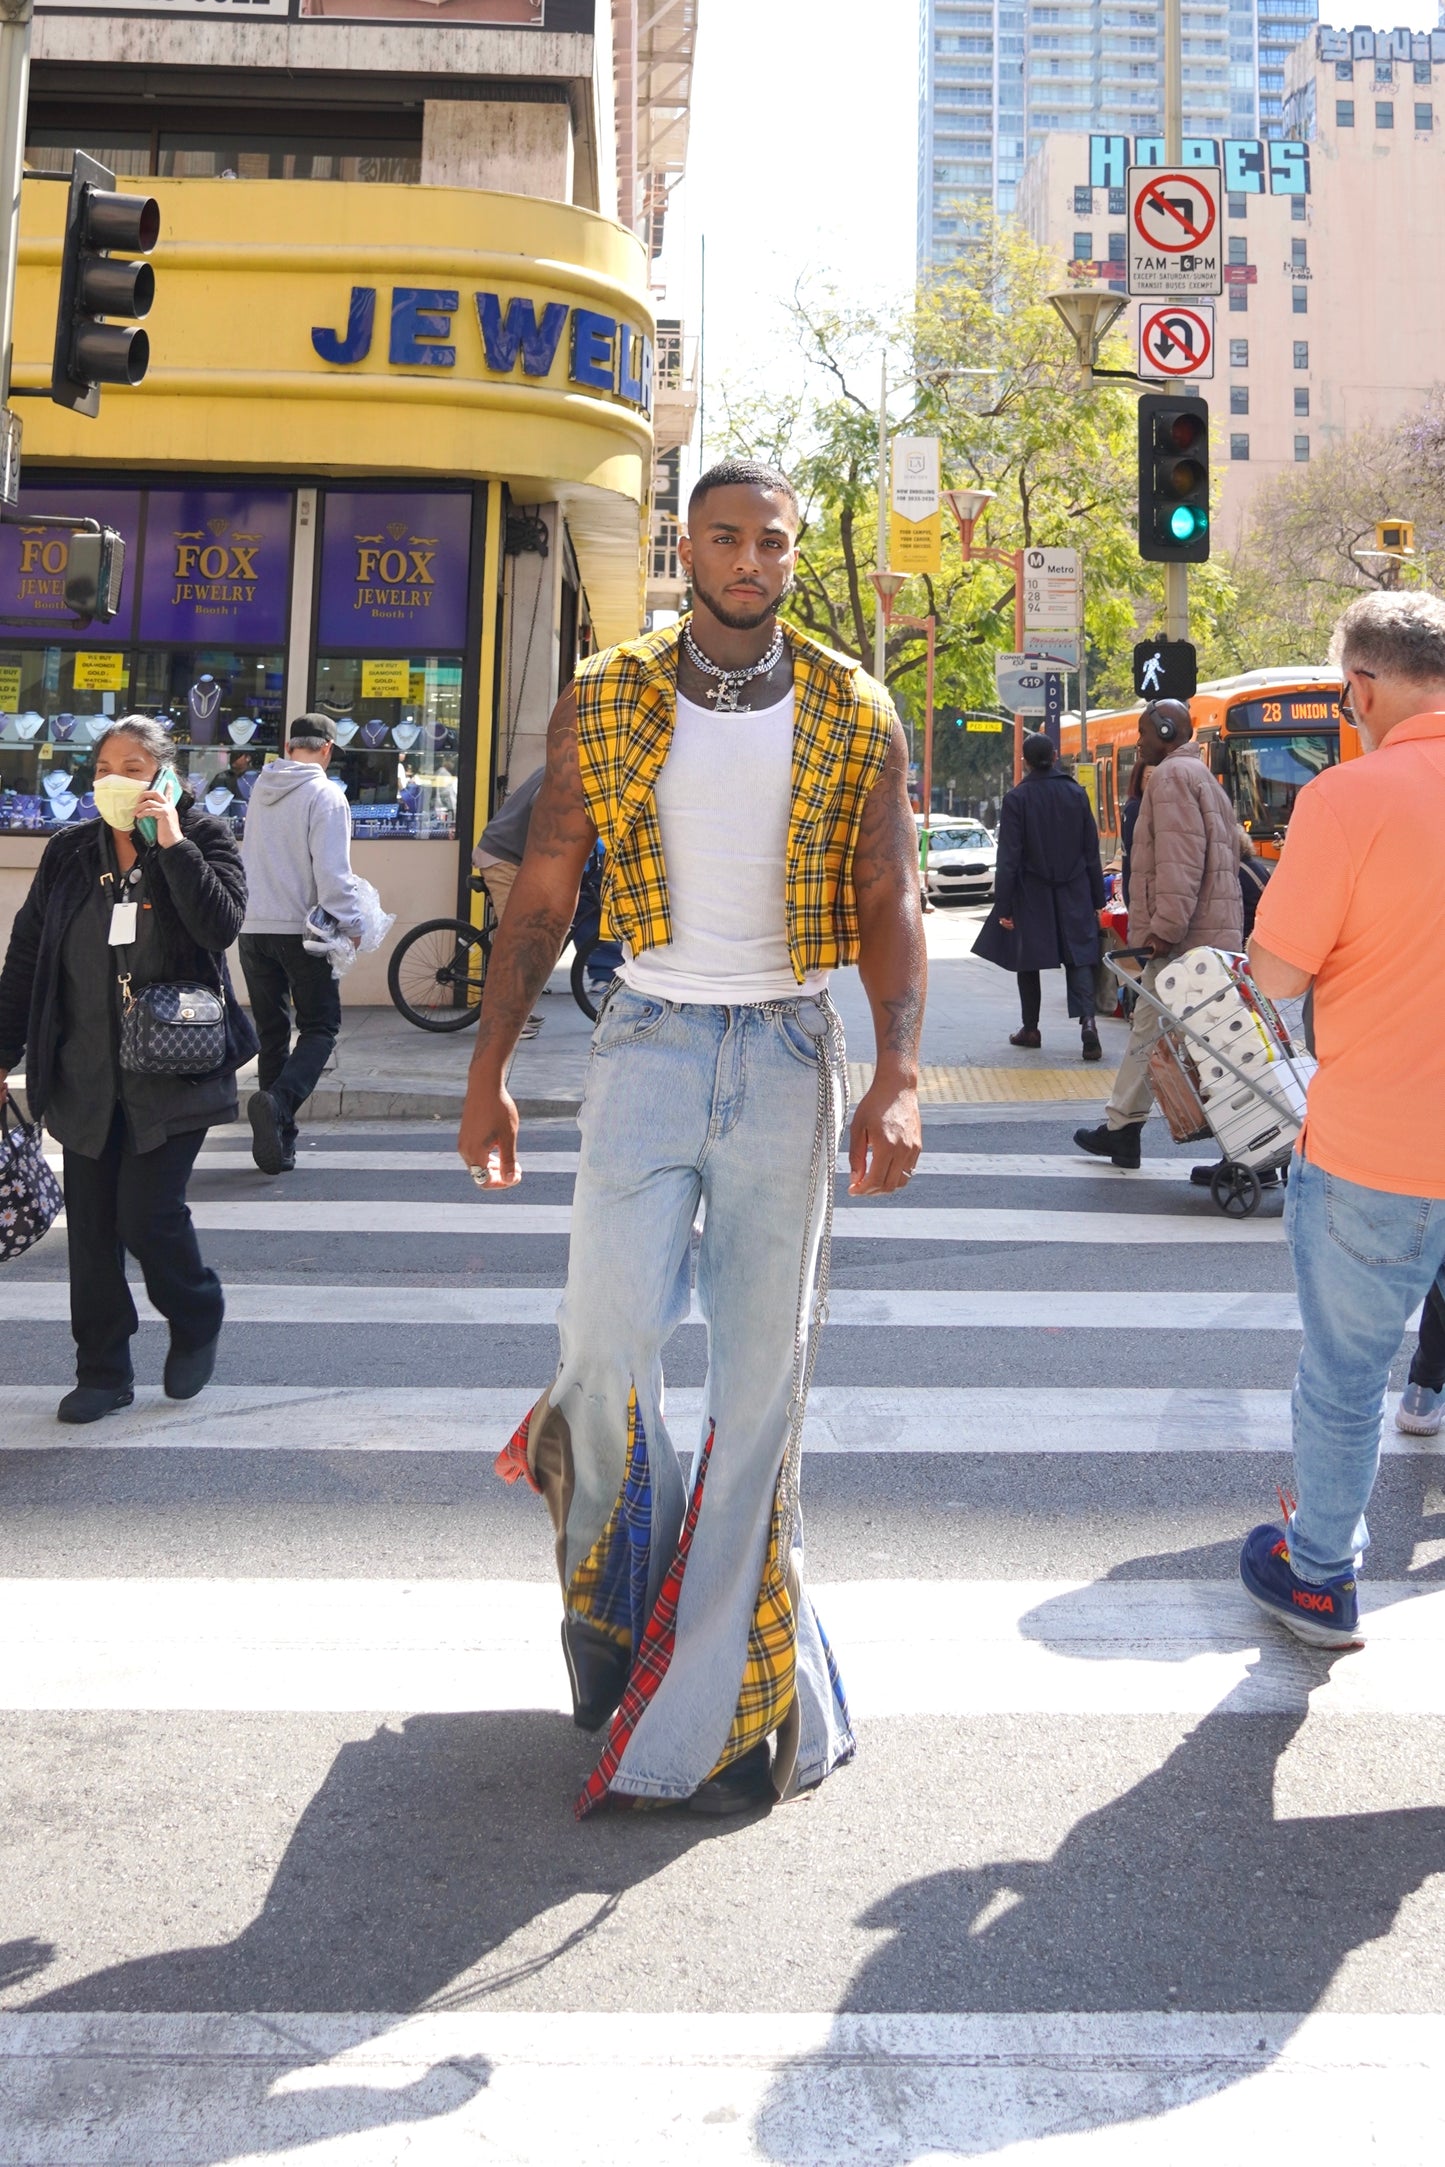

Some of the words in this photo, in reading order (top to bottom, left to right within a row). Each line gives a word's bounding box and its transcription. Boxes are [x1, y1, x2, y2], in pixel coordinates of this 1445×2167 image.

[1133, 272, 1156, 280] EXCEPT
[1165, 282, 1186, 290] BUSES
[20, 540, 68, 574] FO
[174, 545, 259, 579] FOX
[355, 548, 436, 584] FOX
[1048, 565, 1074, 573] Metro
[17, 579, 66, 600] JEWE
[1027, 580, 1038, 589] 10
[171, 584, 257, 605] JEWELRY
[353, 588, 433, 610] JEWELRY
[1027, 591, 1041, 601] 28
[195, 605, 229, 615] Booth
[1027, 603, 1041, 612] 94
[371, 608, 405, 618] Booth
[1022, 678, 1040, 687] 419
[1262, 703, 1282, 722] 28
[1291, 703, 1328, 719] UNION
[1291, 1589, 1335, 1613] HOKA
